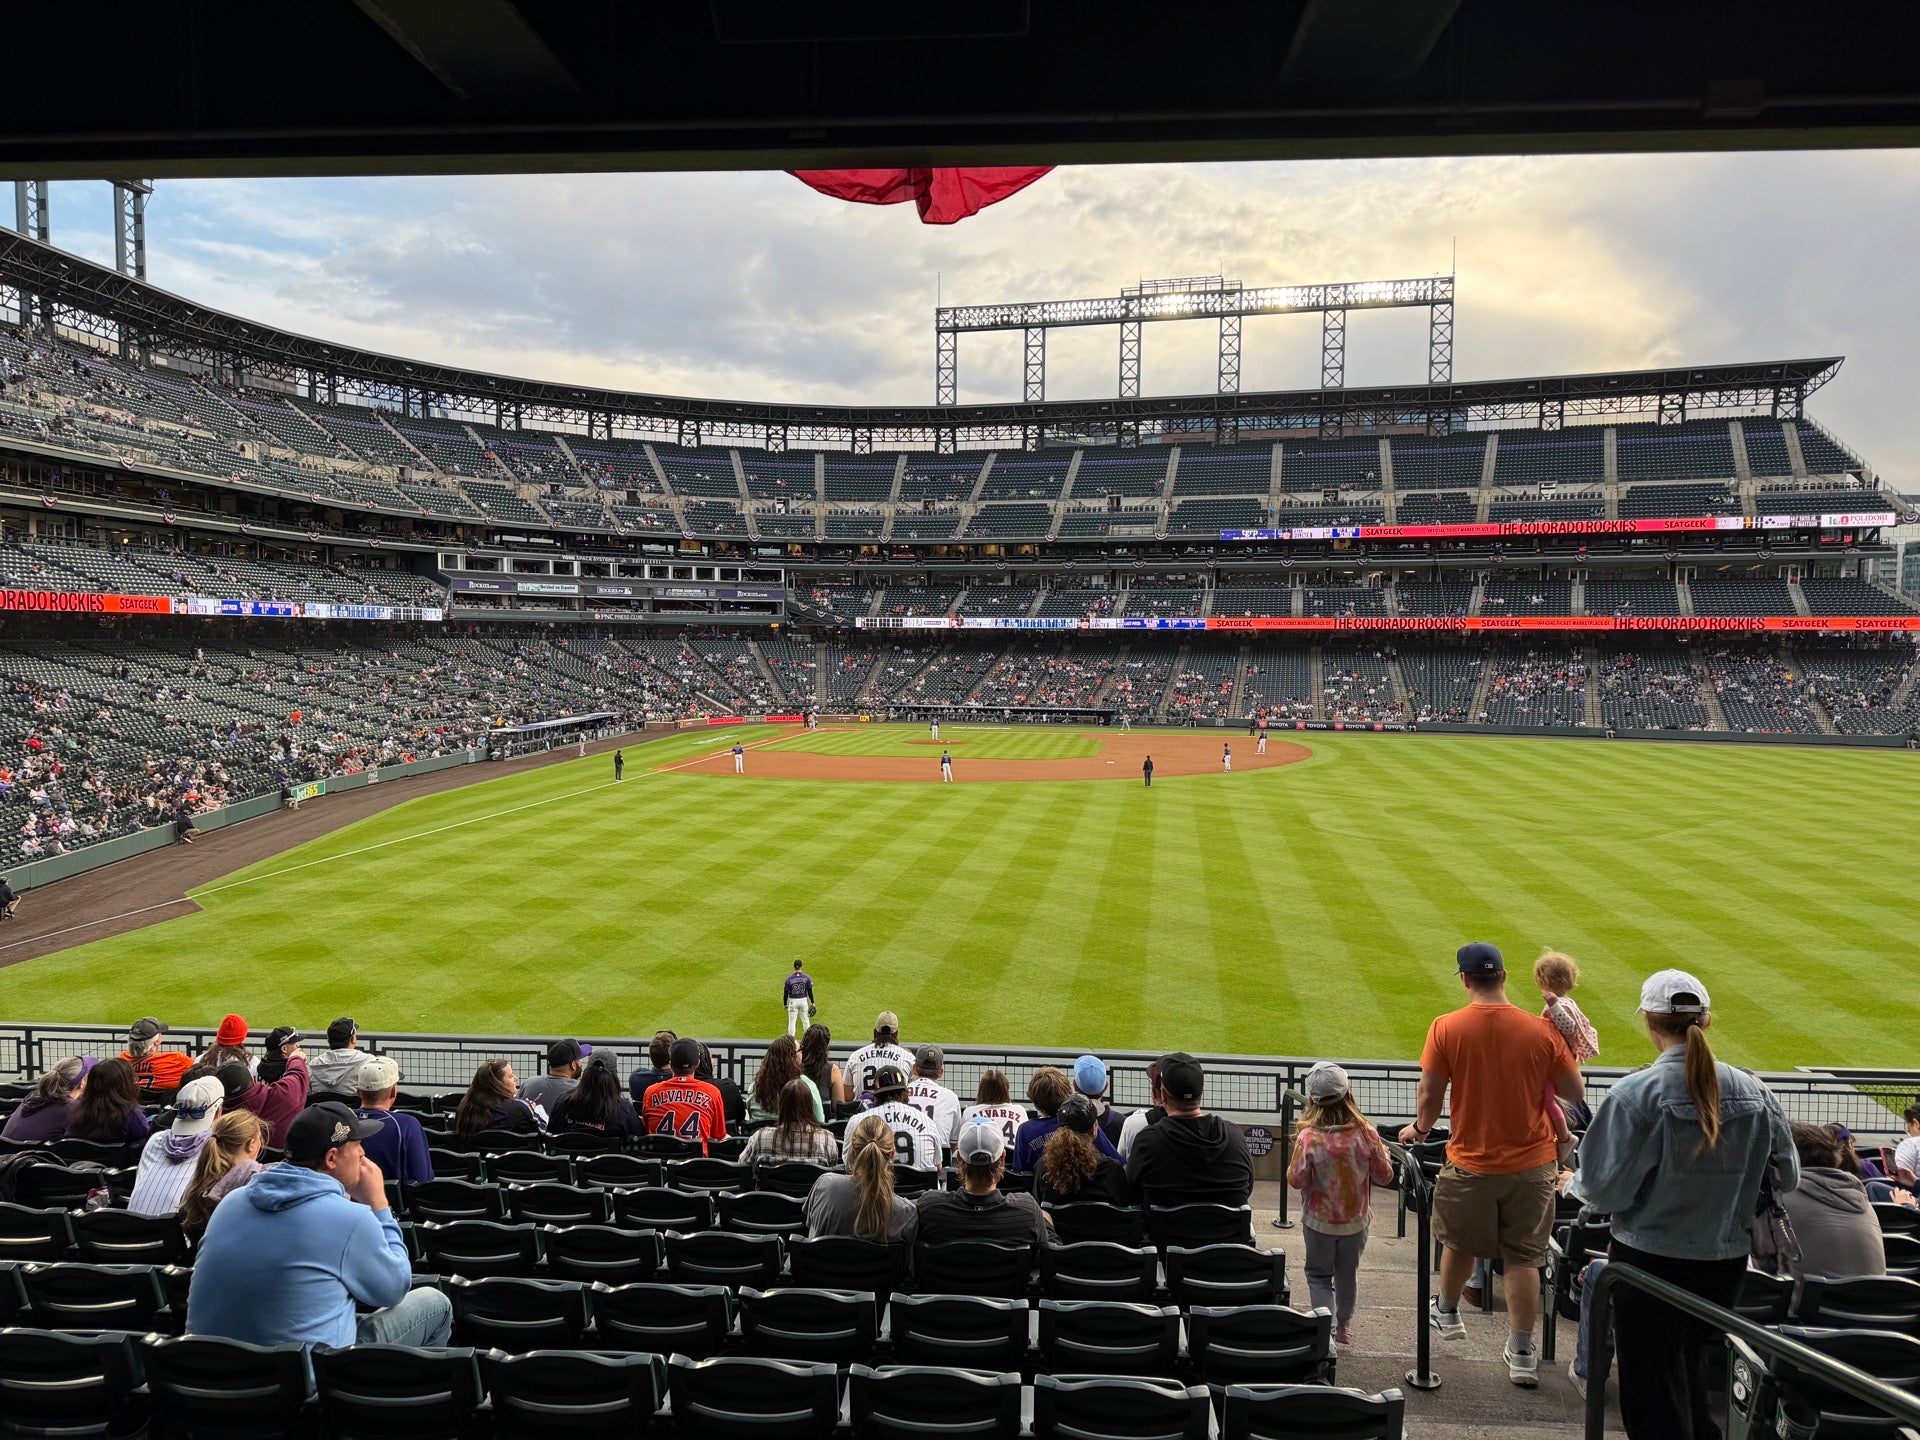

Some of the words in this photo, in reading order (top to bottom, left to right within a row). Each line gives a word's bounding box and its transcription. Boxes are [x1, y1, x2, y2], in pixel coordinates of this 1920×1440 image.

[1664, 520, 1707, 529] SEATGEEK
[1850, 514, 1887, 522] POLIDORI
[1366, 528, 1403, 536] SEATGEEK
[1497, 523, 1516, 535] THE
[1519, 521, 1584, 535] COLORADO
[1587, 520, 1637, 533] ROCKIES
[50, 592, 104, 612] ROCKIES
[120, 597, 159, 611] SEATGEEK
[1217, 620, 1253, 628] SEATGEEK
[1333, 618, 1351, 630] THE
[1354, 618, 1415, 630] COLORADO
[1418, 618, 1467, 630] ROCKIES
[1481, 619, 1522, 628] SEATGEEK
[1612, 618, 1634, 630] THE
[1637, 617, 1706, 630] COLORADO
[1709, 618, 1765, 630] ROCKIES
[1782, 619, 1829, 629] SEATGEEK
[1855, 619, 1908, 629] SEATGEEK
[297, 784, 318, 799] bet365
[791, 983, 806, 995] 20
[859, 1050, 901, 1062] CLEMENS
[863, 1065, 877, 1092] 2
[652, 1089, 712, 1107] ALVAREZ
[656, 1111, 701, 1139] 44
[885, 1112, 926, 1134] CKMON
[1252, 1128, 1265, 1137] NO
[894, 1131, 915, 1166] 9
